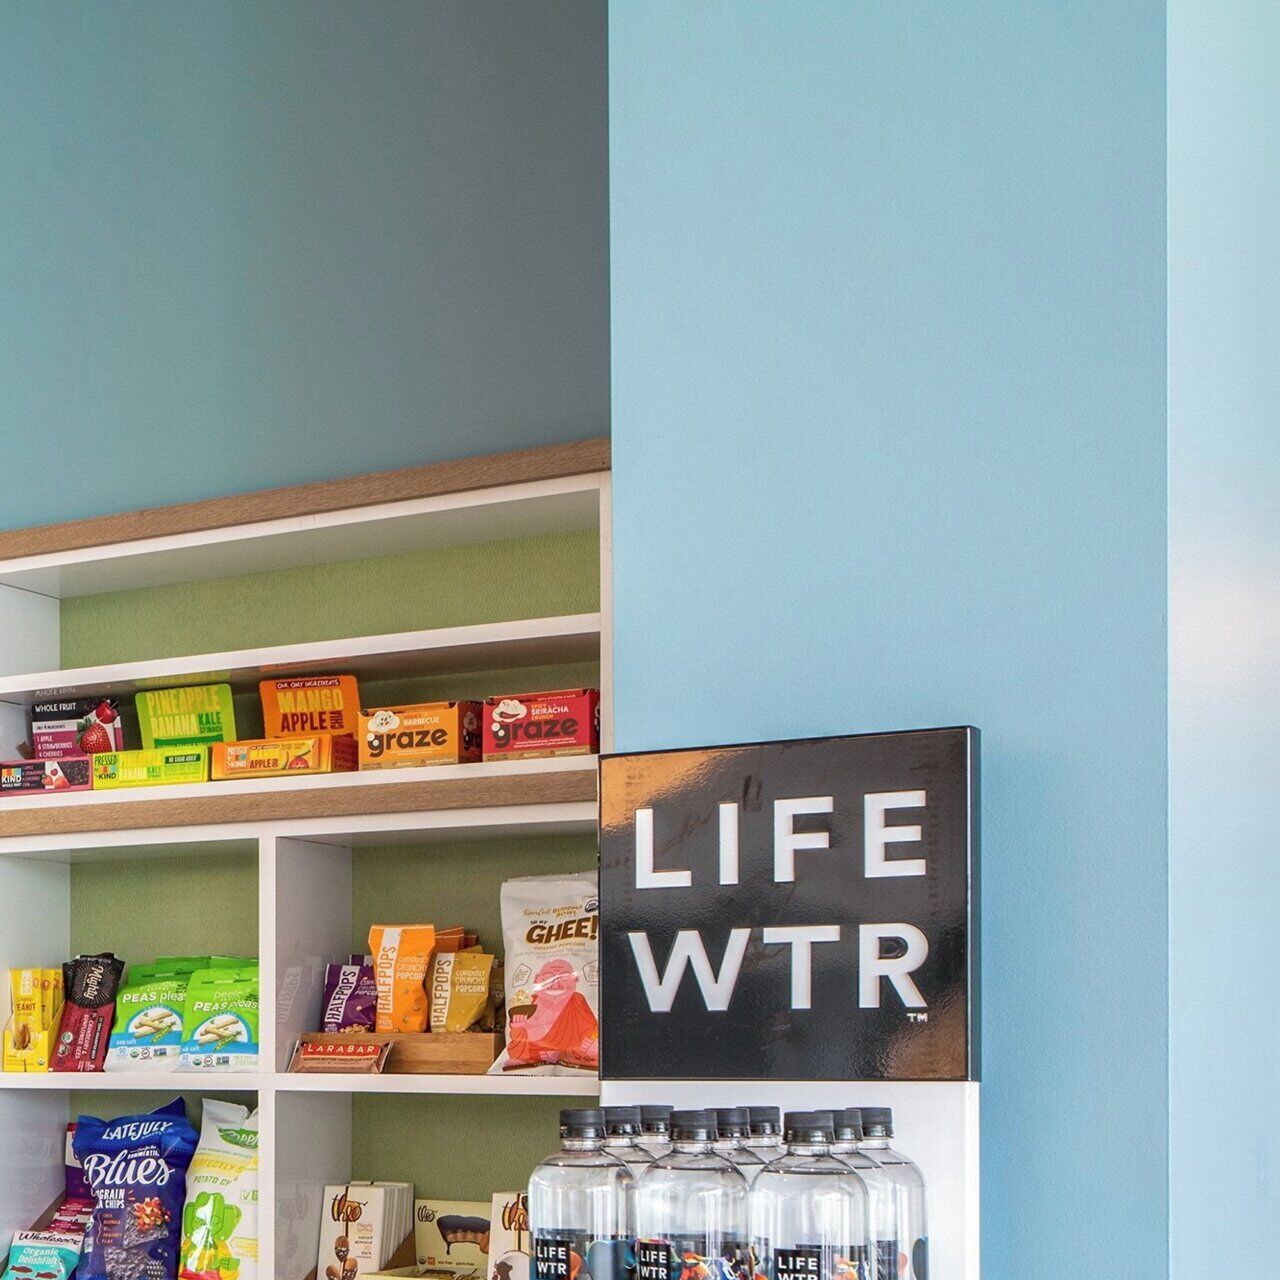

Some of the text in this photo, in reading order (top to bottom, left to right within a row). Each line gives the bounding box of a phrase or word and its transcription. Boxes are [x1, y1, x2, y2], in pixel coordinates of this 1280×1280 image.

[35, 703, 76, 712] WHOLE FRUIT
[147, 687, 220, 716] PINEAPPLE
[278, 689, 344, 712] MANGO
[531, 706, 569, 715] SRIRACHA
[151, 712, 221, 737] BANANA KALE
[281, 711, 327, 732] APPLE
[404, 717, 440, 726] BARBECUE
[492, 718, 578, 748] graze
[367, 729, 447, 757] graze
[95, 755, 117, 764] PRESSED
[250, 758, 271, 769] APPLE
[635, 790, 926, 889] LIFE
[526, 915, 598, 944] GHEE!
[628, 923, 929, 1012] WTR
[84, 966, 104, 999] Mighty
[379, 944, 396, 1012] HALFPOPS
[123, 993, 156, 1003] PEAS
[326, 970, 356, 1020] HALFPOPS
[433, 959, 451, 1024] HALFPOPS
[194, 1001, 228, 1012] PEAS
[307, 1044, 375, 1053] LARABAR
[84, 1149, 175, 1188] Blues
[105, 1201, 125, 1209] CHIPS
[19, 1233, 80, 1245] Wholesome
[23, 1248, 58, 1256] Organic
[536, 1244, 567, 1260] LIFE
[640, 1250, 667, 1265] LIFE
[537, 1261, 567, 1276] WTR
[777, 1256, 818, 1271] LIFE
[640, 1266, 667, 1280] WTR
